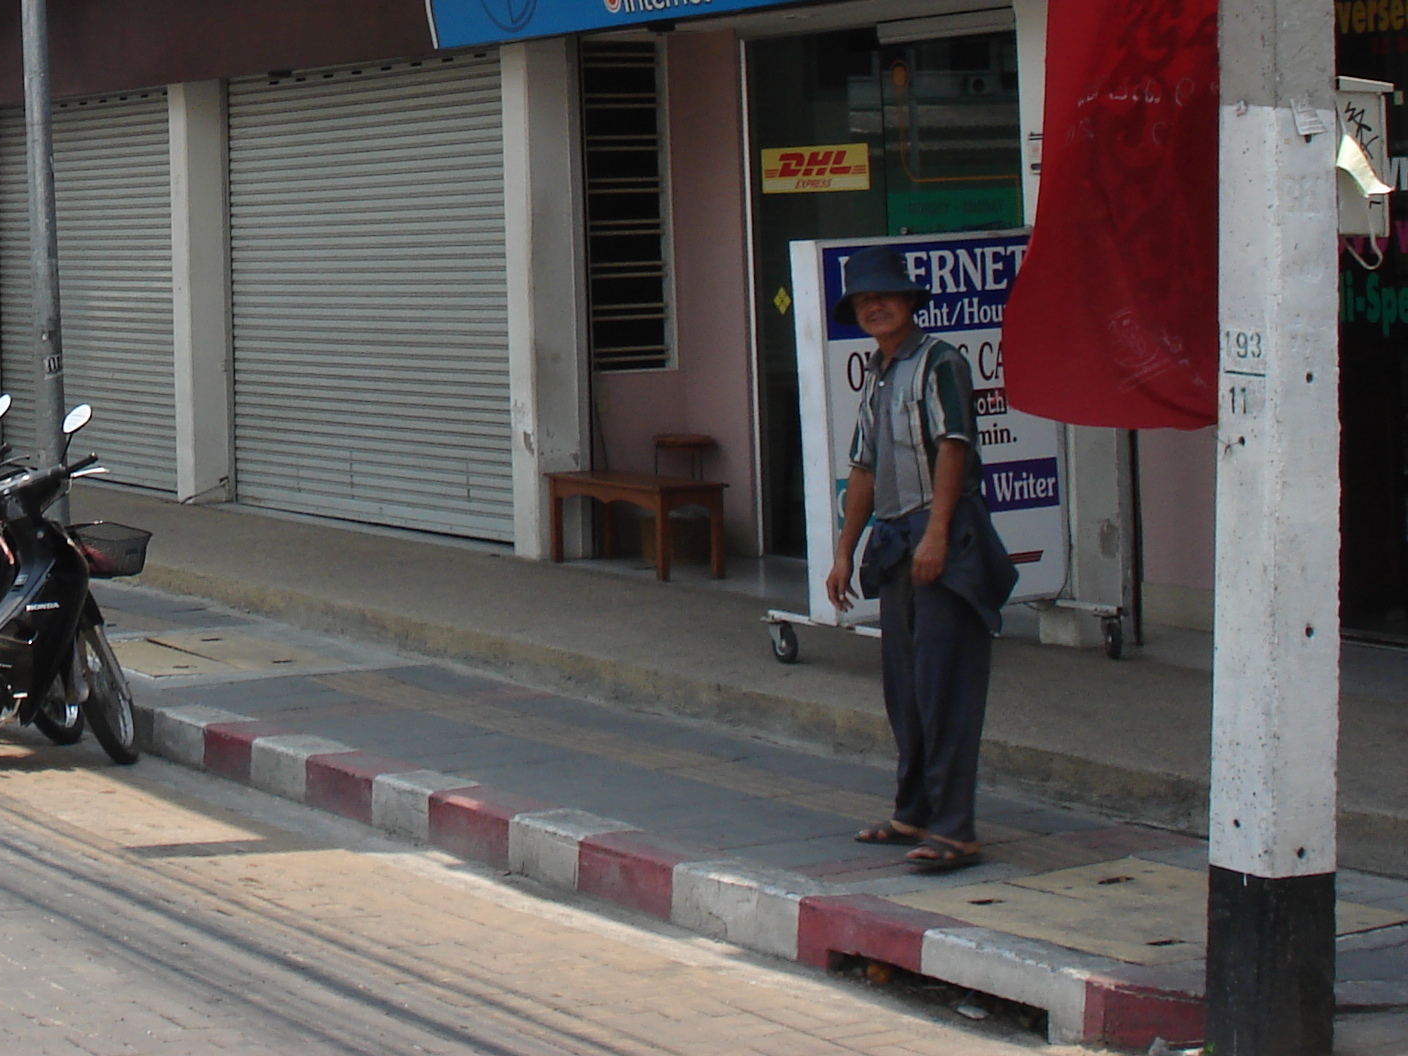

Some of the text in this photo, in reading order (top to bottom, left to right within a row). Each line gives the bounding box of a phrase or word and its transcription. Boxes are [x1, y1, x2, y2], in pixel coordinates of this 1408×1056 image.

[778, 150, 853, 178] DHL
[795, 178, 833, 189] EXPRESS
[838, 245, 1028, 295] IERNET
[1225, 330, 1262, 358] 193
[1229, 386, 1247, 414] 11
[992, 472, 1056, 502] Writer
[26, 602, 60, 612] HONDA
